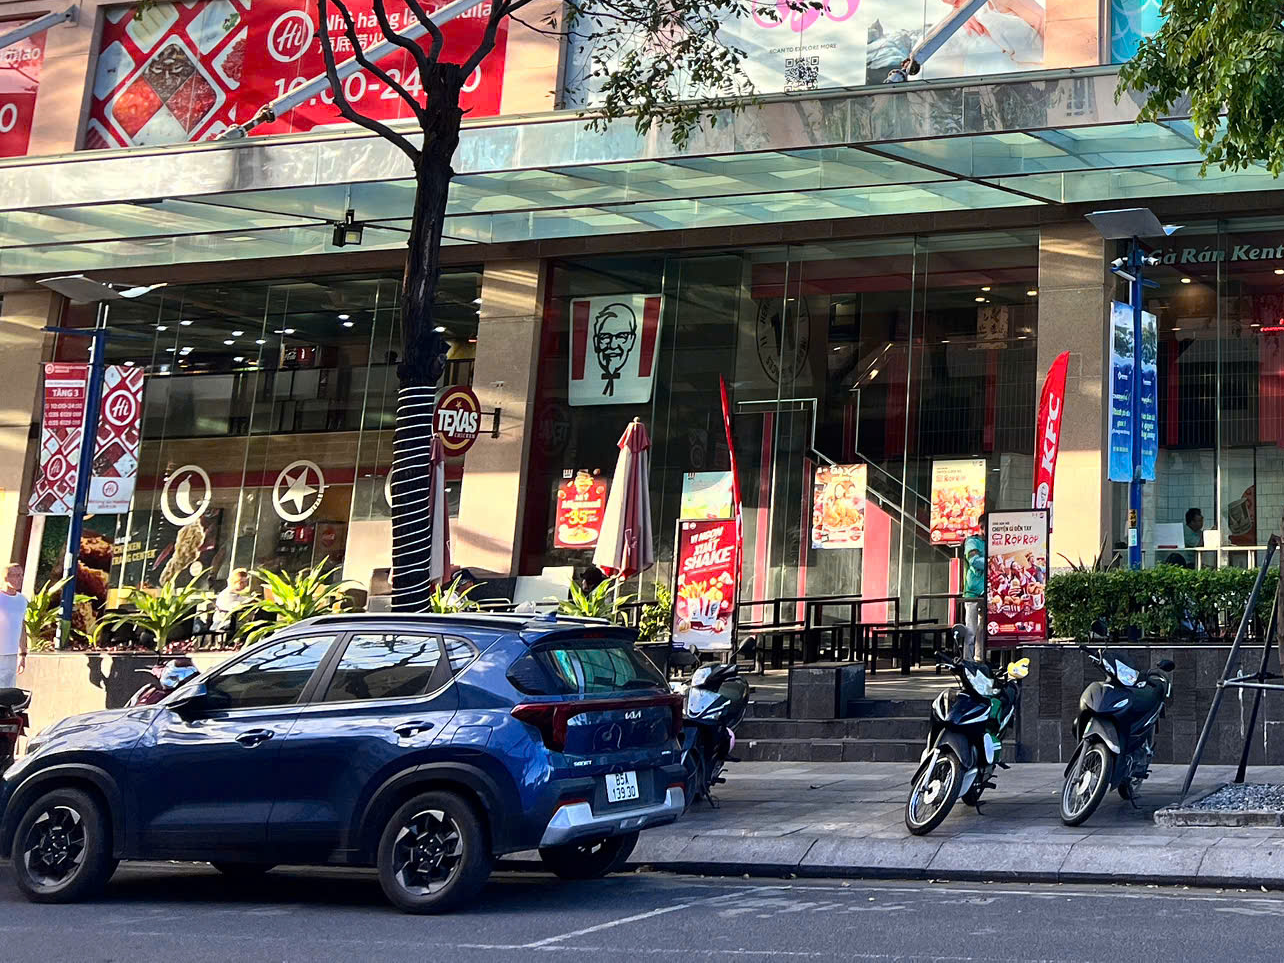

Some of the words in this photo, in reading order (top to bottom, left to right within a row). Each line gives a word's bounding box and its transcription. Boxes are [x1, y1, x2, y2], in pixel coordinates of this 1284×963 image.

[1181, 244, 1225, 264] Rán
[438, 409, 478, 437] TEXAS
[1042, 393, 1061, 476] KFC
[684, 545, 735, 571] SHAKE
